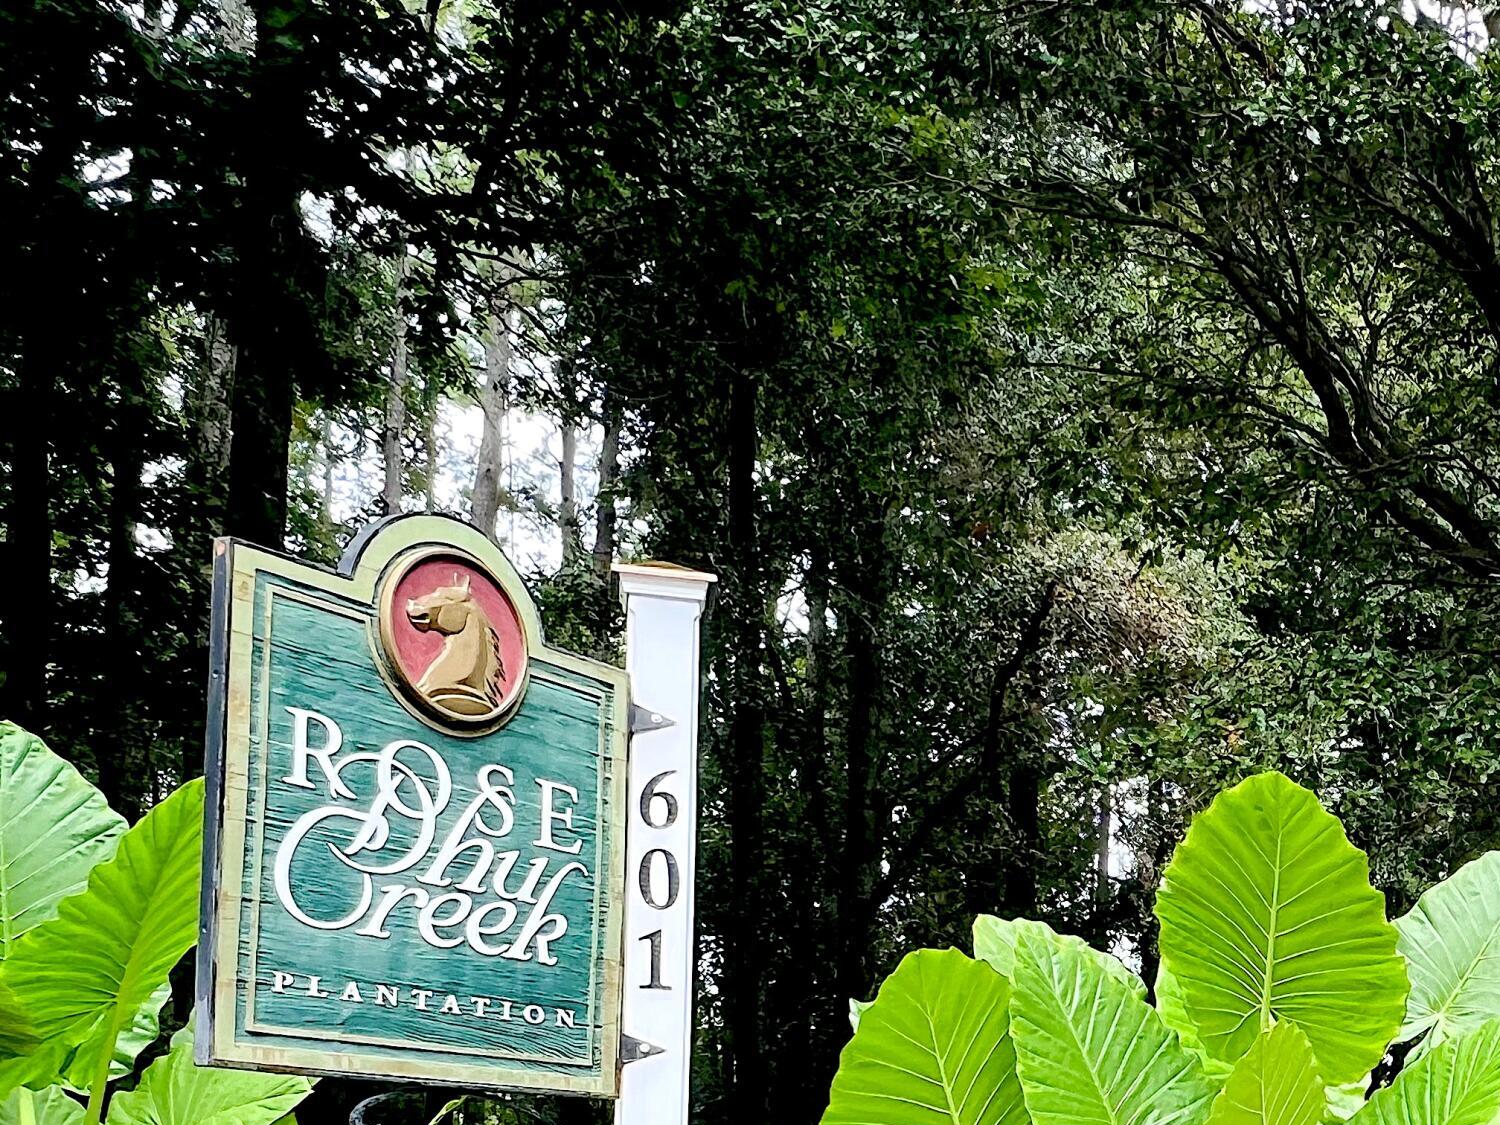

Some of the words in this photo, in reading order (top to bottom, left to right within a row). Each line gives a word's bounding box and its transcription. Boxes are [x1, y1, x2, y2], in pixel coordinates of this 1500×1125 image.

[281, 705, 583, 855] ROSE
[274, 806, 589, 966] Creek
[637, 769, 681, 991] 601
[271, 970, 578, 1029] PLANTATION
